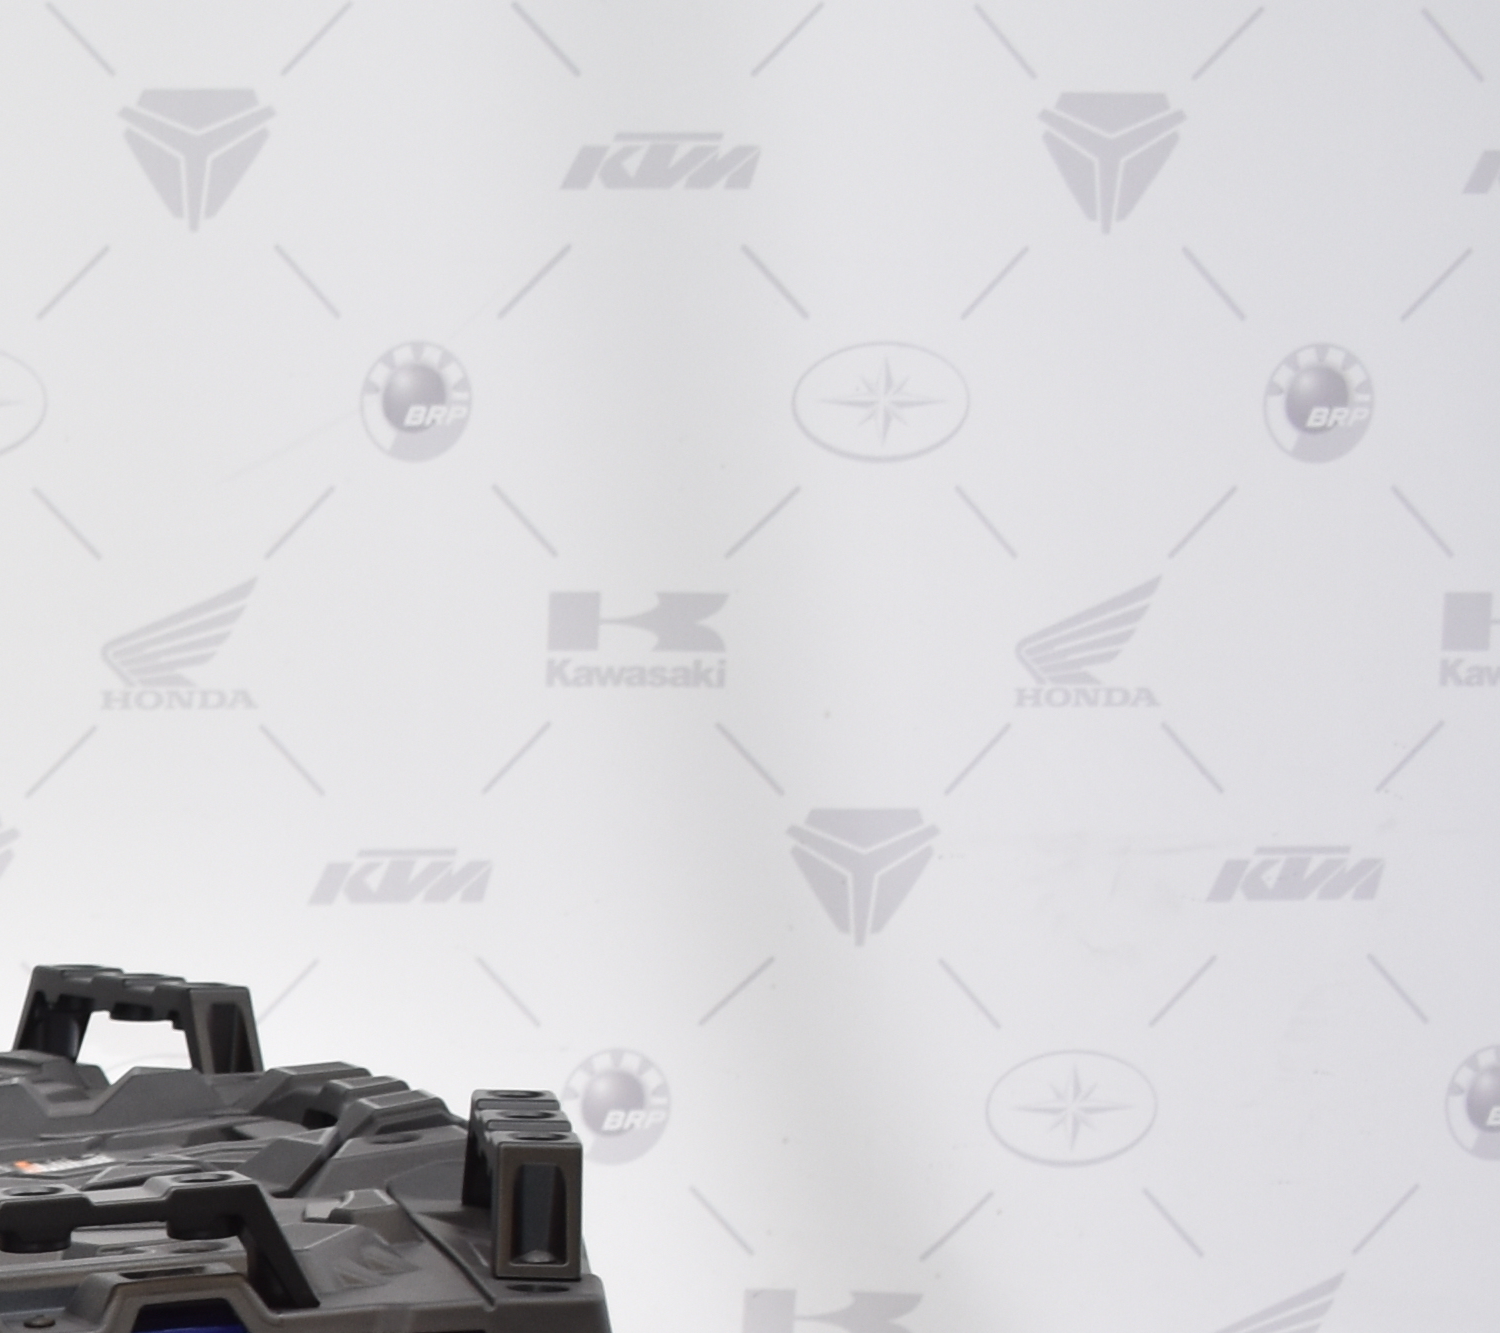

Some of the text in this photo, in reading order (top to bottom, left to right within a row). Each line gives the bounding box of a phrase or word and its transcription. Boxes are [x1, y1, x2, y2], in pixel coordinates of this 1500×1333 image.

[562, 131, 760, 191] KTM
[402, 403, 472, 428] BRP
[1306, 405, 1370, 428] BRP
[545, 660, 728, 690] Kawasaki
[100, 690, 258, 710] HONDA
[1015, 688, 1160, 708] HONDA
[311, 847, 493, 904] KTM
[1208, 844, 1385, 902] KTM
[603, 1108, 665, 1130] BRP
